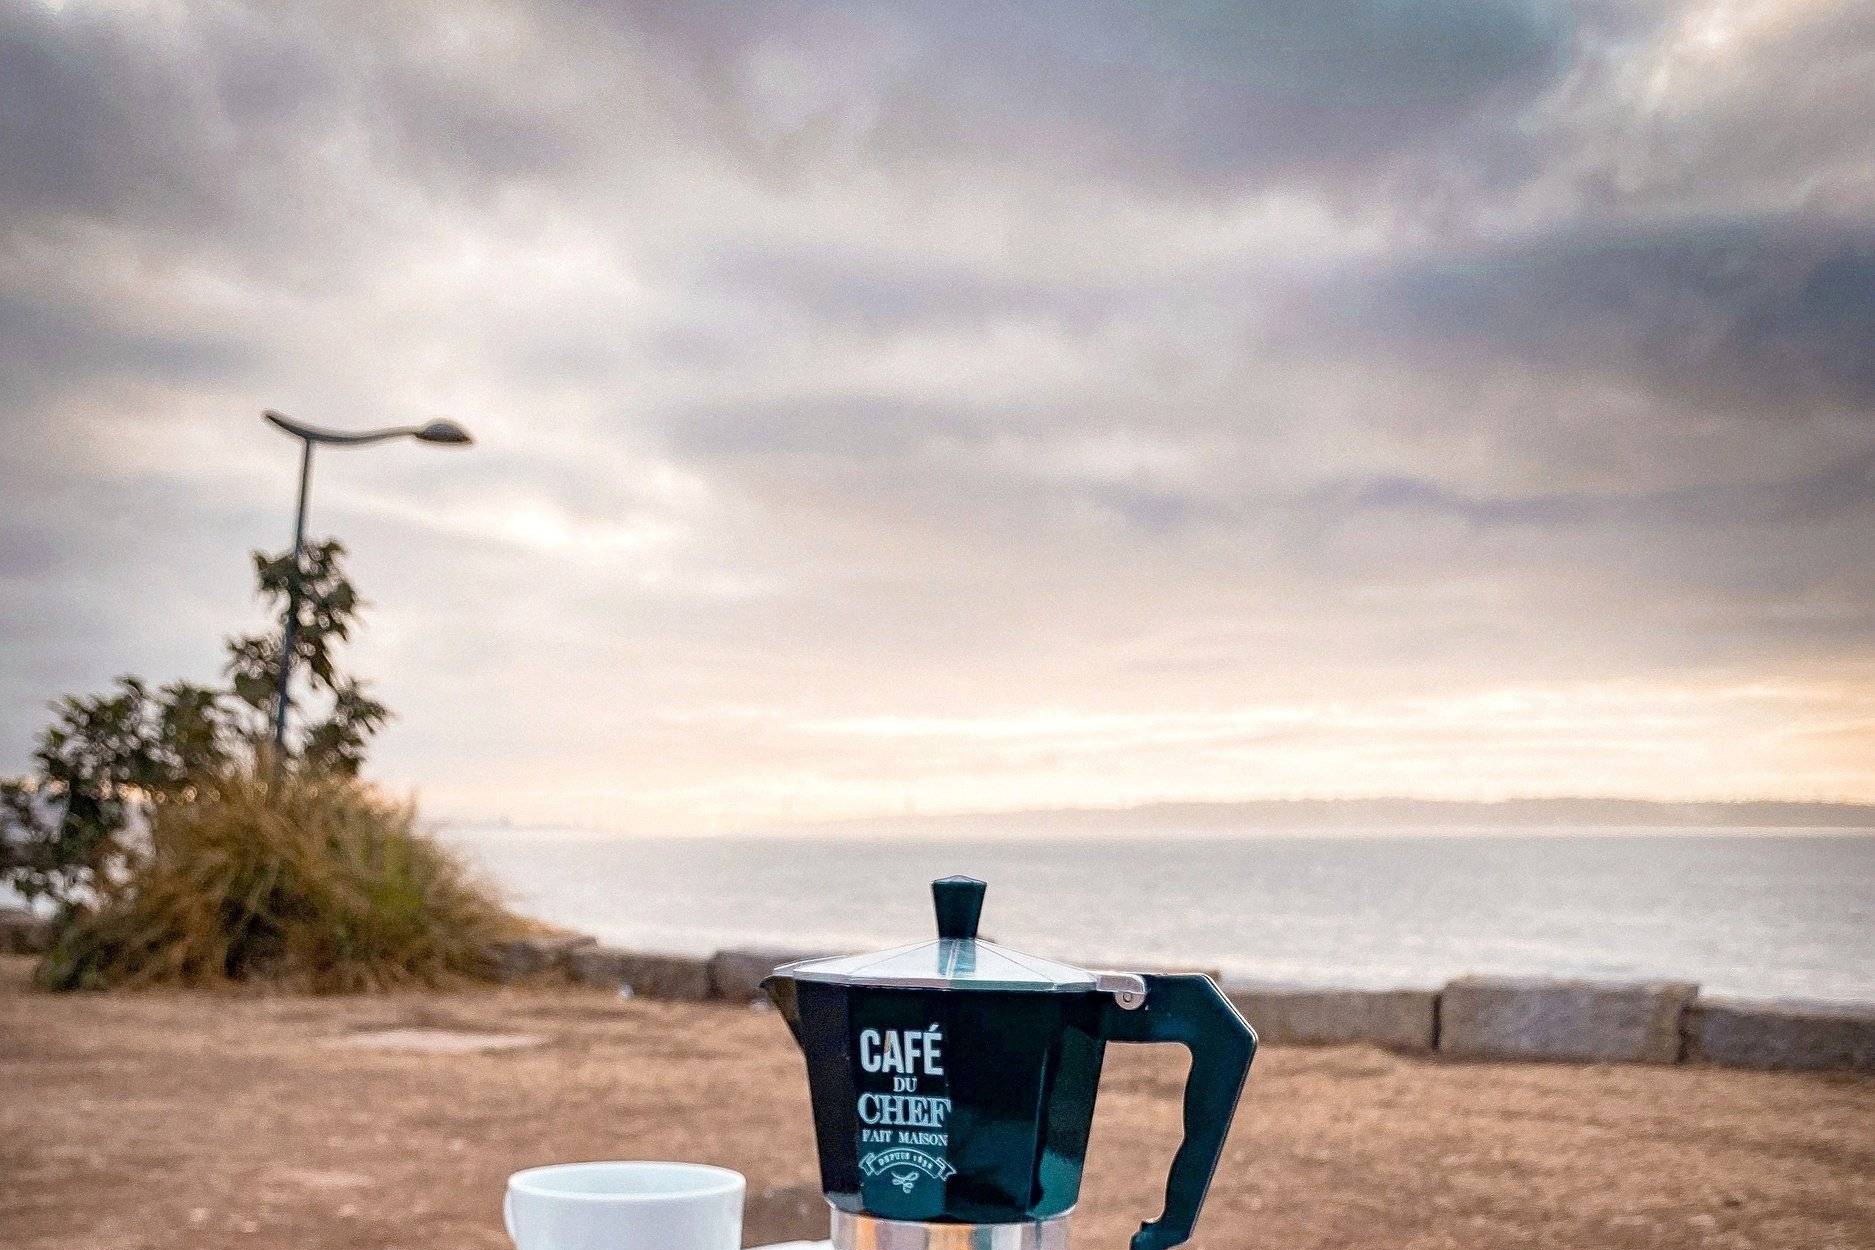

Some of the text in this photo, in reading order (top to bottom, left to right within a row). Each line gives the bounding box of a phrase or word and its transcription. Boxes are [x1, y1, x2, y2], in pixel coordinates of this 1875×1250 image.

[859, 1023, 944, 1075] CAFÉ
[893, 1077, 918, 1092] DU
[857, 1093, 952, 1127] CHEF
[862, 1129, 948, 1146] FAIT MAISON
